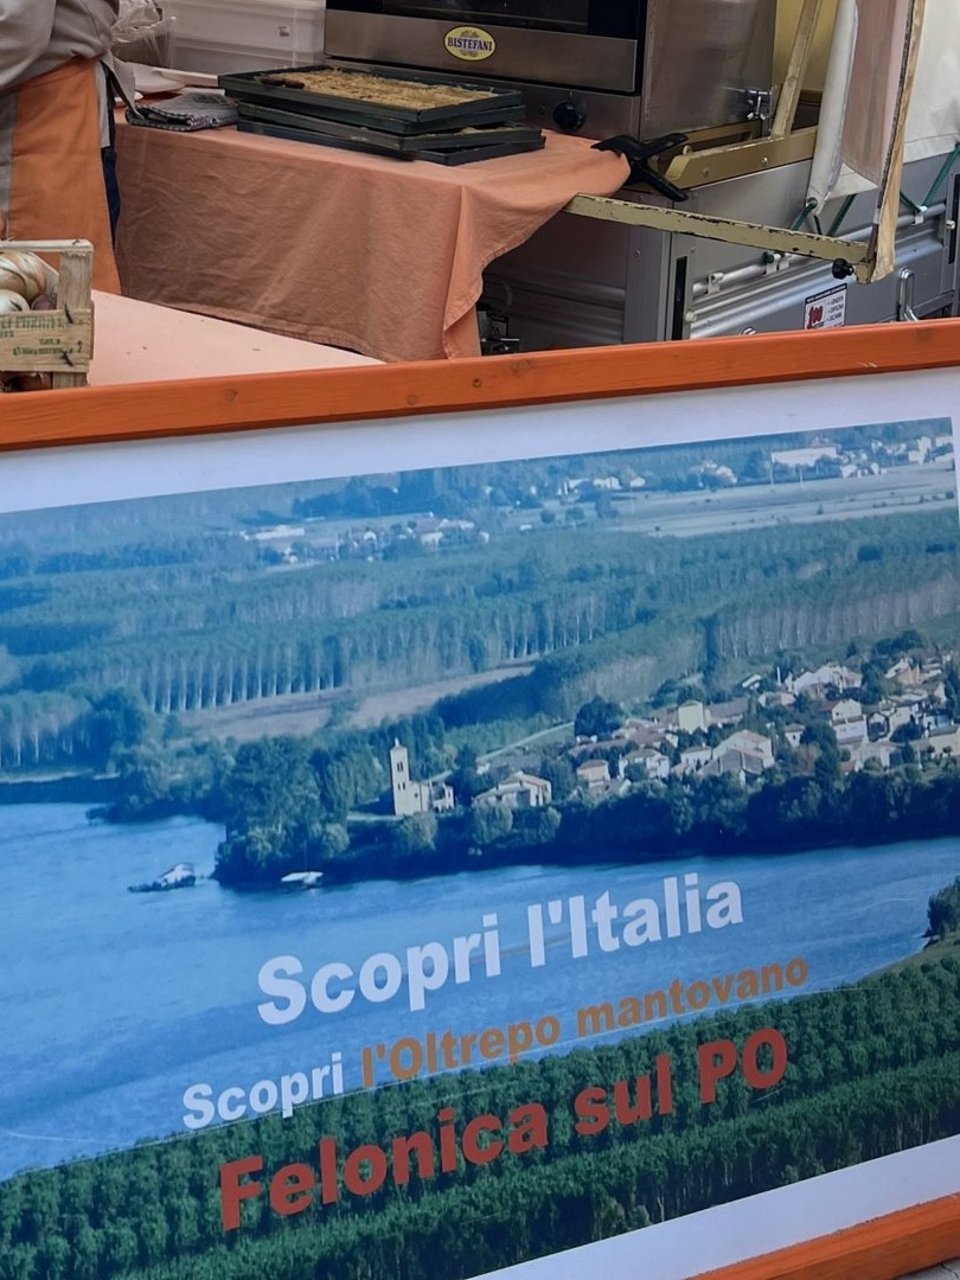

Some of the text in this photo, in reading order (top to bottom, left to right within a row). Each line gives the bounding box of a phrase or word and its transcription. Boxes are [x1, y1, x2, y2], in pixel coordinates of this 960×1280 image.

[447, 36, 493, 52] BISTEFANI
[257, 873, 743, 1026] Scopri l'Italia
[183, 957, 808, 1129] Scopri l'Oltrepo mantovano
[218, 1028, 788, 1233] Felonica sul PO
